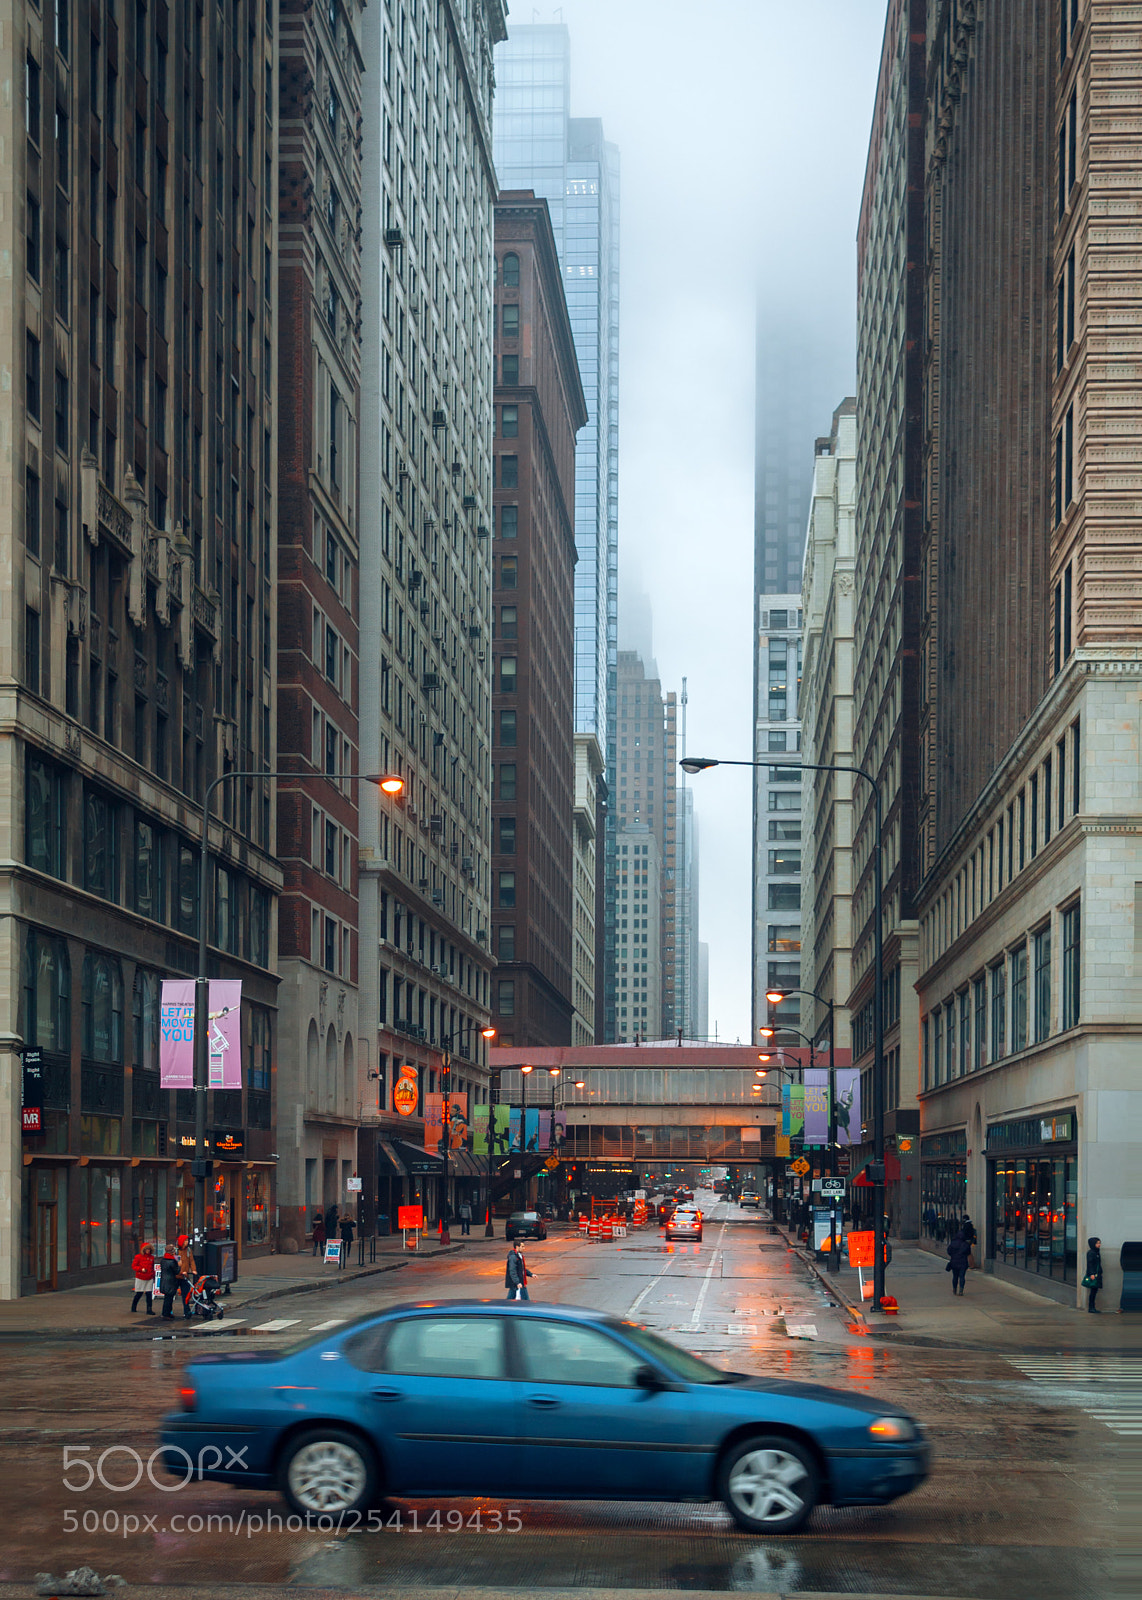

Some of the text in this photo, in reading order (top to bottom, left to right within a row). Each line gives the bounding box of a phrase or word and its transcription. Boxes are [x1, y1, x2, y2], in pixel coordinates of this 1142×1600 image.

[161, 1007, 193, 1017] LET IT
[161, 1018, 193, 1028] MOVE
[162, 1028, 194, 1042] YOU
[804, 1087, 818, 1095] LET
[804, 1095, 828, 1103] MOVE
[804, 1103, 828, 1112] YOU
[23, 1113, 39, 1124] MR
